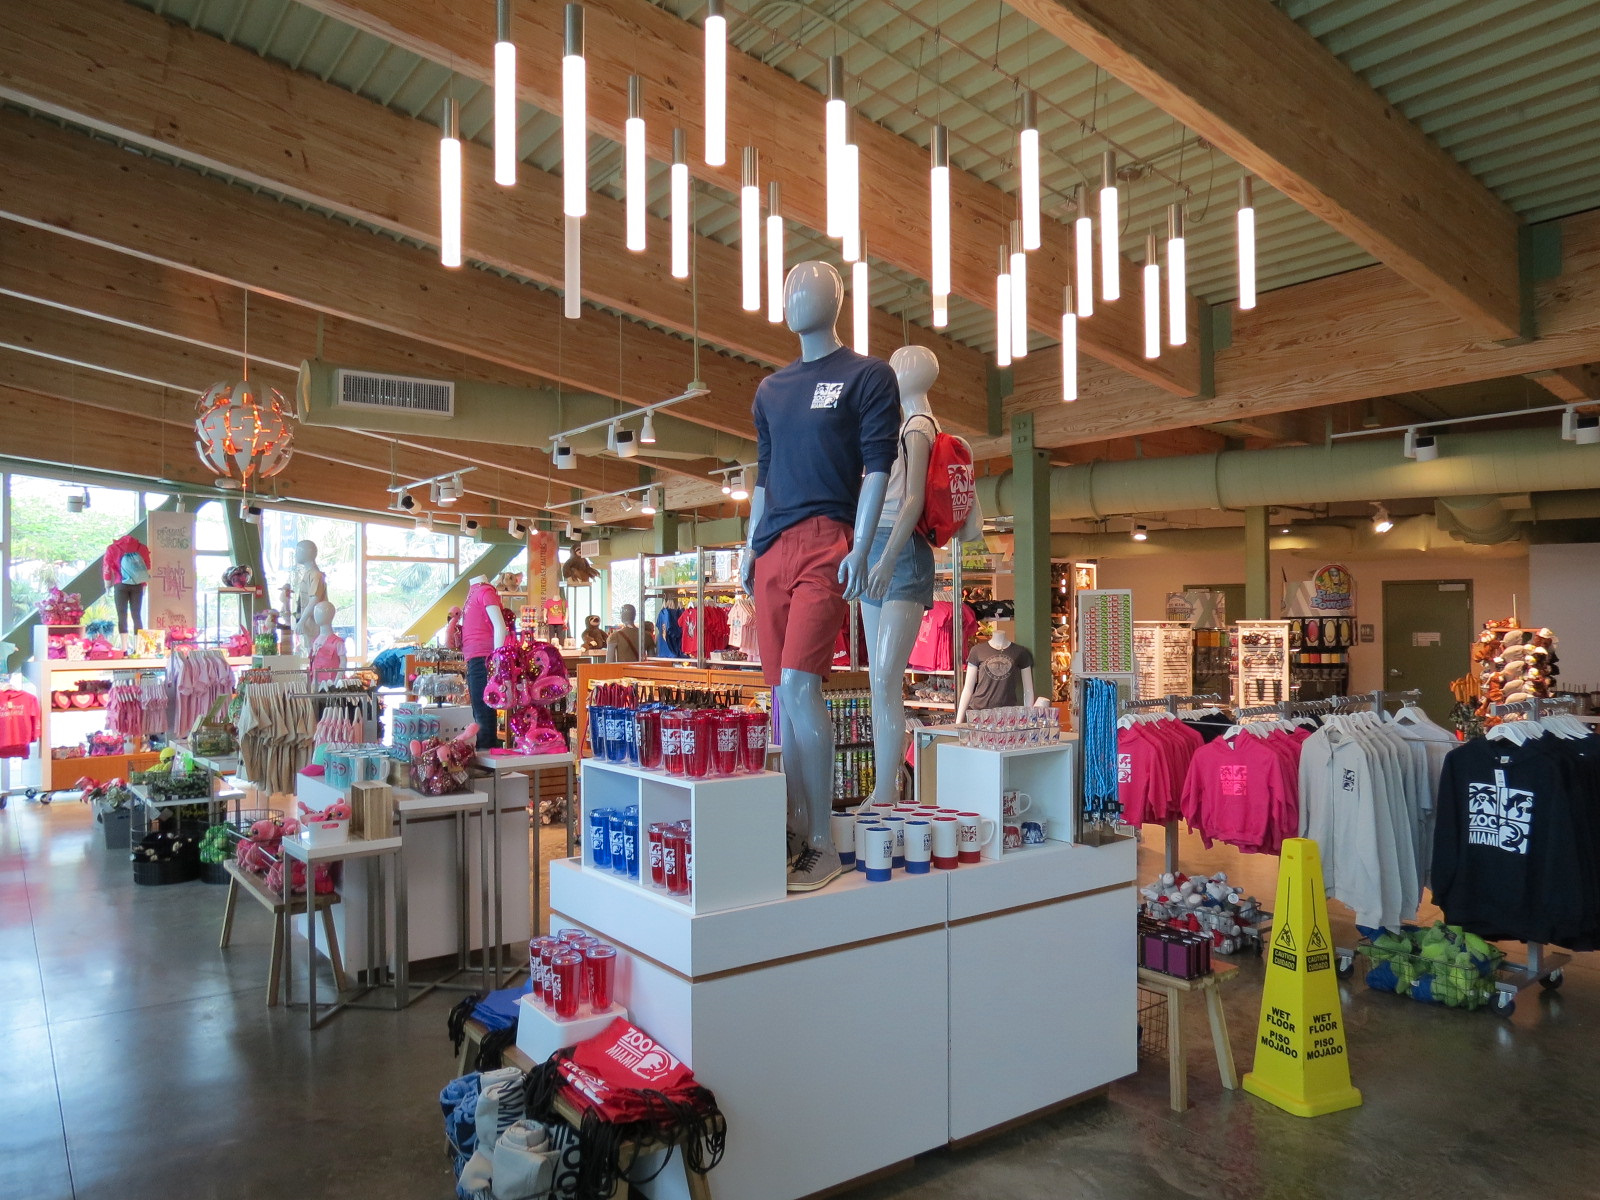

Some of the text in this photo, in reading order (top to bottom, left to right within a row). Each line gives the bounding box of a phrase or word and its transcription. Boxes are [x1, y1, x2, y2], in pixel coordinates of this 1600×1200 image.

[951, 493, 968, 506] ZOO
[157, 564, 186, 577] STAND
[1468, 831, 1499, 848] MIAMI
[1274, 949, 1296, 962] CAUTION
[1307, 954, 1328, 963] CAUTION
[1274, 956, 1295, 970] CUIDADO
[1272, 1006, 1291, 1021] WET
[1313, 1012, 1332, 1024] WET
[1266, 1014, 1296, 1034] FLOOR
[1309, 1021, 1338, 1035] FLOOR
[621, 1026, 653, 1053] ZOO
[1270, 1030, 1290, 1046] PISO
[1314, 1037, 1335, 1049] PISO
[1260, 1036, 1298, 1059] MOJADO
[1306, 1045, 1344, 1061] MOJADO
[604, 1043, 640, 1070] MIAMI
